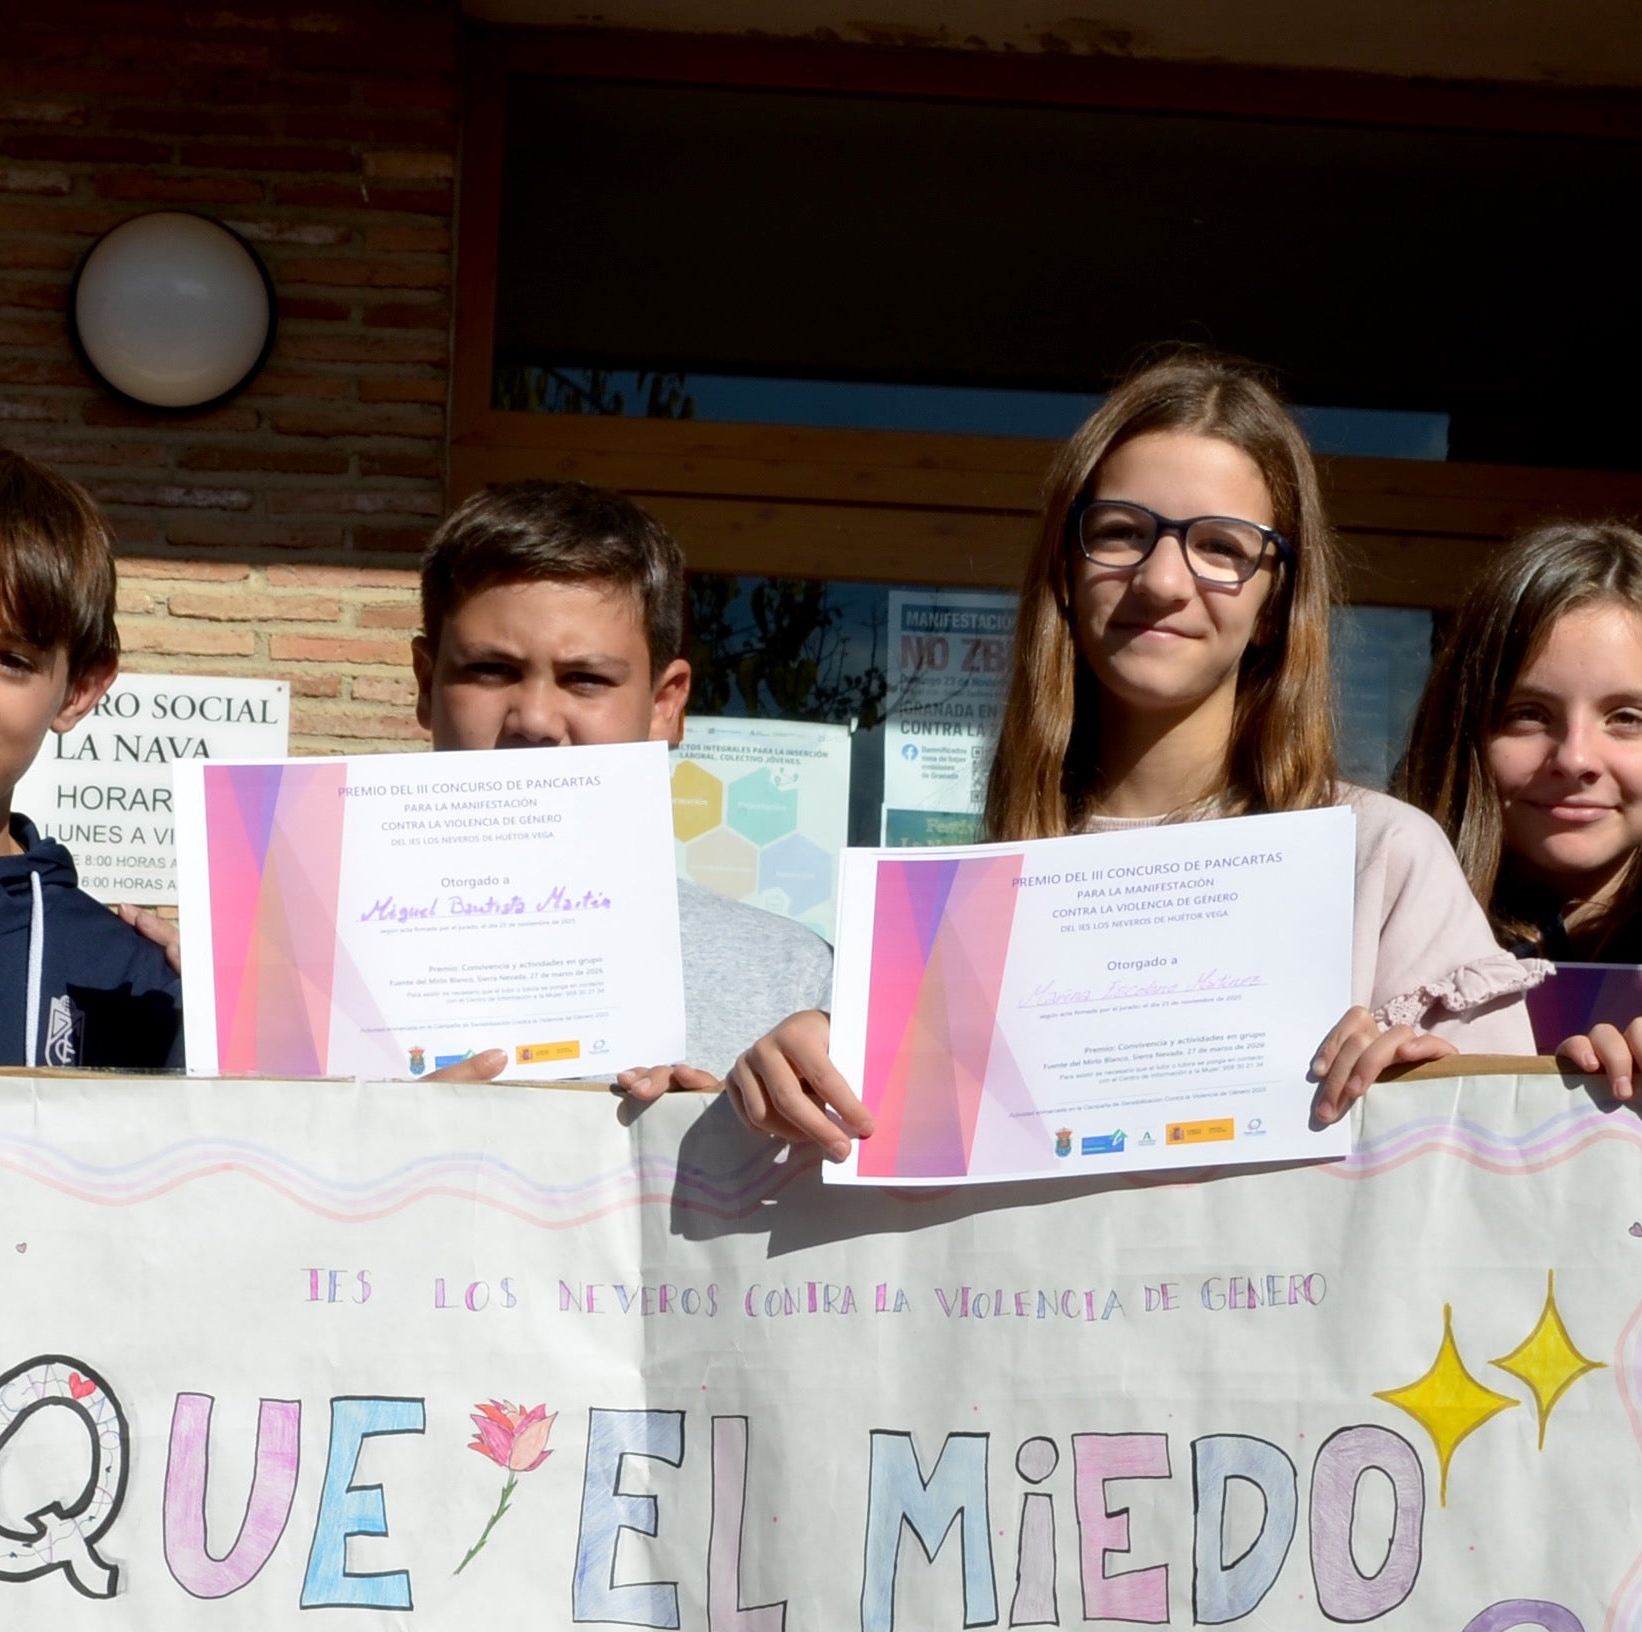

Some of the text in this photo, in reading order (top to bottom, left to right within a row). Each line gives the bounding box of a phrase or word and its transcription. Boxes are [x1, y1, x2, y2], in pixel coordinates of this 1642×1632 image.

[906, 610, 1013, 630] MANIFESTACIÓ
[901, 636, 1012, 673] NO ZB
[151, 693, 278, 725] SOCIAL
[900, 720, 985, 737] CONTRA LA
[54, 733, 211, 764] LA NAVA
[703, 744, 751, 753] INTEGRALES
[752, 746, 773, 754] PARA
[786, 747, 828, 759] INSERCIÓN
[337, 776, 601, 798] PREMIO DEL III CONCURSO DE PANCARTAS
[57, 784, 173, 813] HORAR
[404, 796, 537, 813] PARA LA MANIFESTACIÓN
[381, 811, 562, 831] CONTRA LA VIOLENCIA DE GÉNERO
[130, 827, 146, 844] A
[84, 855, 112, 867] 8:00
[116, 856, 166, 869] HORAS
[1011, 852, 1283, 888] PREMIO DEL III CONCURSO DE PANCARTAS
[113, 877, 163, 890] HORAS
[440, 874, 510, 890] Otorgado a
[1076, 875, 1214, 899] PARA LA MANIFESTACIÓN
[361, 896, 438, 923] Miguel
[448, 895, 525, 915] Bautista
[1052, 890, 1239, 919] CONTRA LA VIOLENCIA DE GÉNERO
[1106, 955, 1178, 974] Otorgado a
[300, 1267, 1328, 1322] IES LOS NEVEROS CONTRA LA VIOLENCIA DE GENERO
